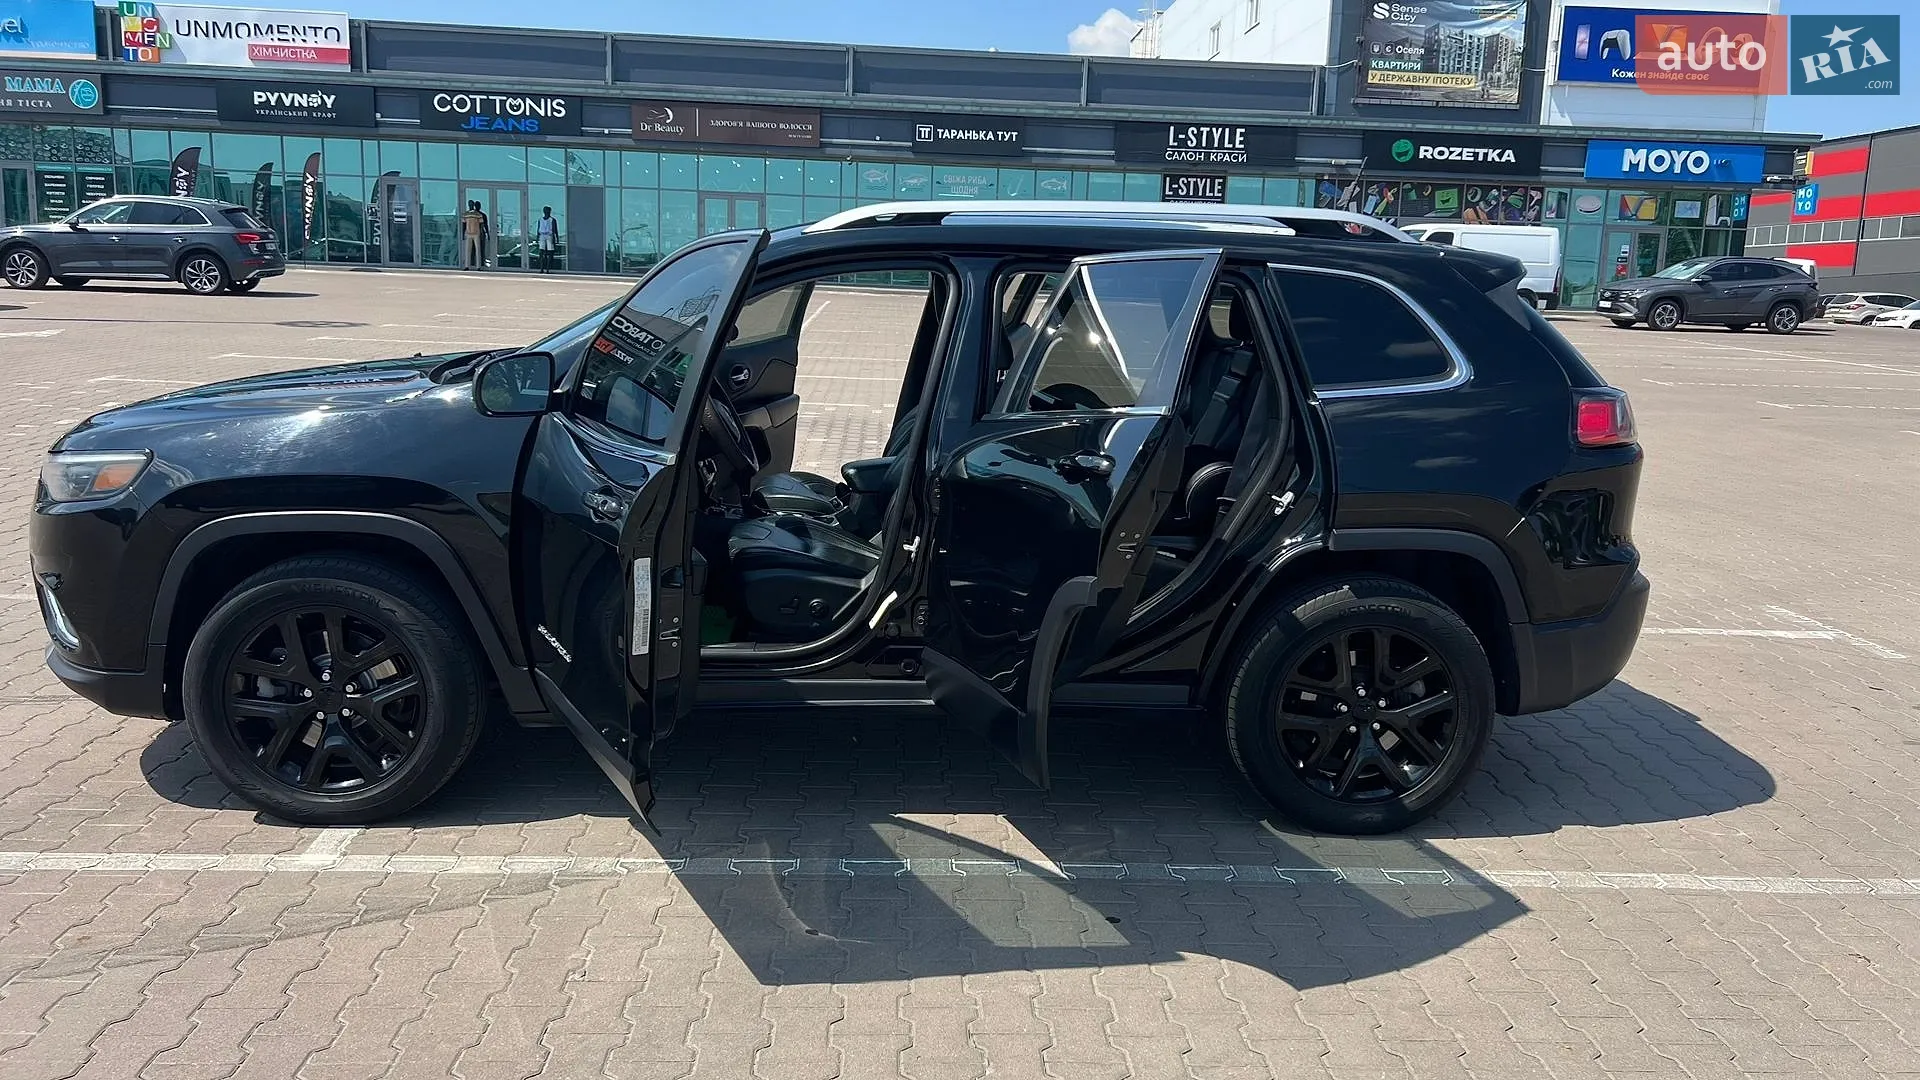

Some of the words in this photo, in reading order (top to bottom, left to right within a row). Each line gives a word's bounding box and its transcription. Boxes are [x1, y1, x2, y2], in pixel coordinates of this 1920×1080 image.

[1391, 3, 1427, 14] Sense
[1391, 12, 1416, 23] City
[0, 16, 23, 34] el
[175, 19, 341, 43] UNMOMENTO
[253, 47, 317, 60] ХІМЧИСТКА
[1396, 45, 1425, 55] Оселя
[1371, 60, 1421, 70] КВАРТИРИ
[1370, 73, 1377, 81] У
[1379, 74, 1432, 83] ДЕРЖАВНУ
[1433, 76, 1473, 86] ІПОТЕКУ
[1612, 68, 1647, 79] Кожен
[1648, 70, 1684, 81] знайде
[18, 99, 52, 108] ТІСТА
[432, 93, 566, 119] COTTONIS
[255, 109, 308, 118] УКРАЇНСЬКИЙ
[461, 116, 540, 133] JEANS
[640, 123, 651, 132] Dr
[655, 123, 686, 136] Beauty
[745, 121, 777, 129] ВАШОГО
[779, 123, 812, 131] ВОЛОССЯ
[937, 128, 994, 141] ТАРАНЬКА
[997, 131, 1018, 142] ТУТ
[1168, 126, 1246, 148] L-STYLE
[1165, 151, 1204, 161] САЛОН
[1210, 152, 1247, 163] КРАСИ
[1419, 145, 1516, 164] ROZETKA
[1622, 148, 1710, 174] MOYO
[943, 174, 966, 183] СВІЖА
[968, 176, 987, 185] РИБА
[951, 186, 978, 195] ЩОДНЯ
[1165, 176, 1223, 197] L-STYLE
